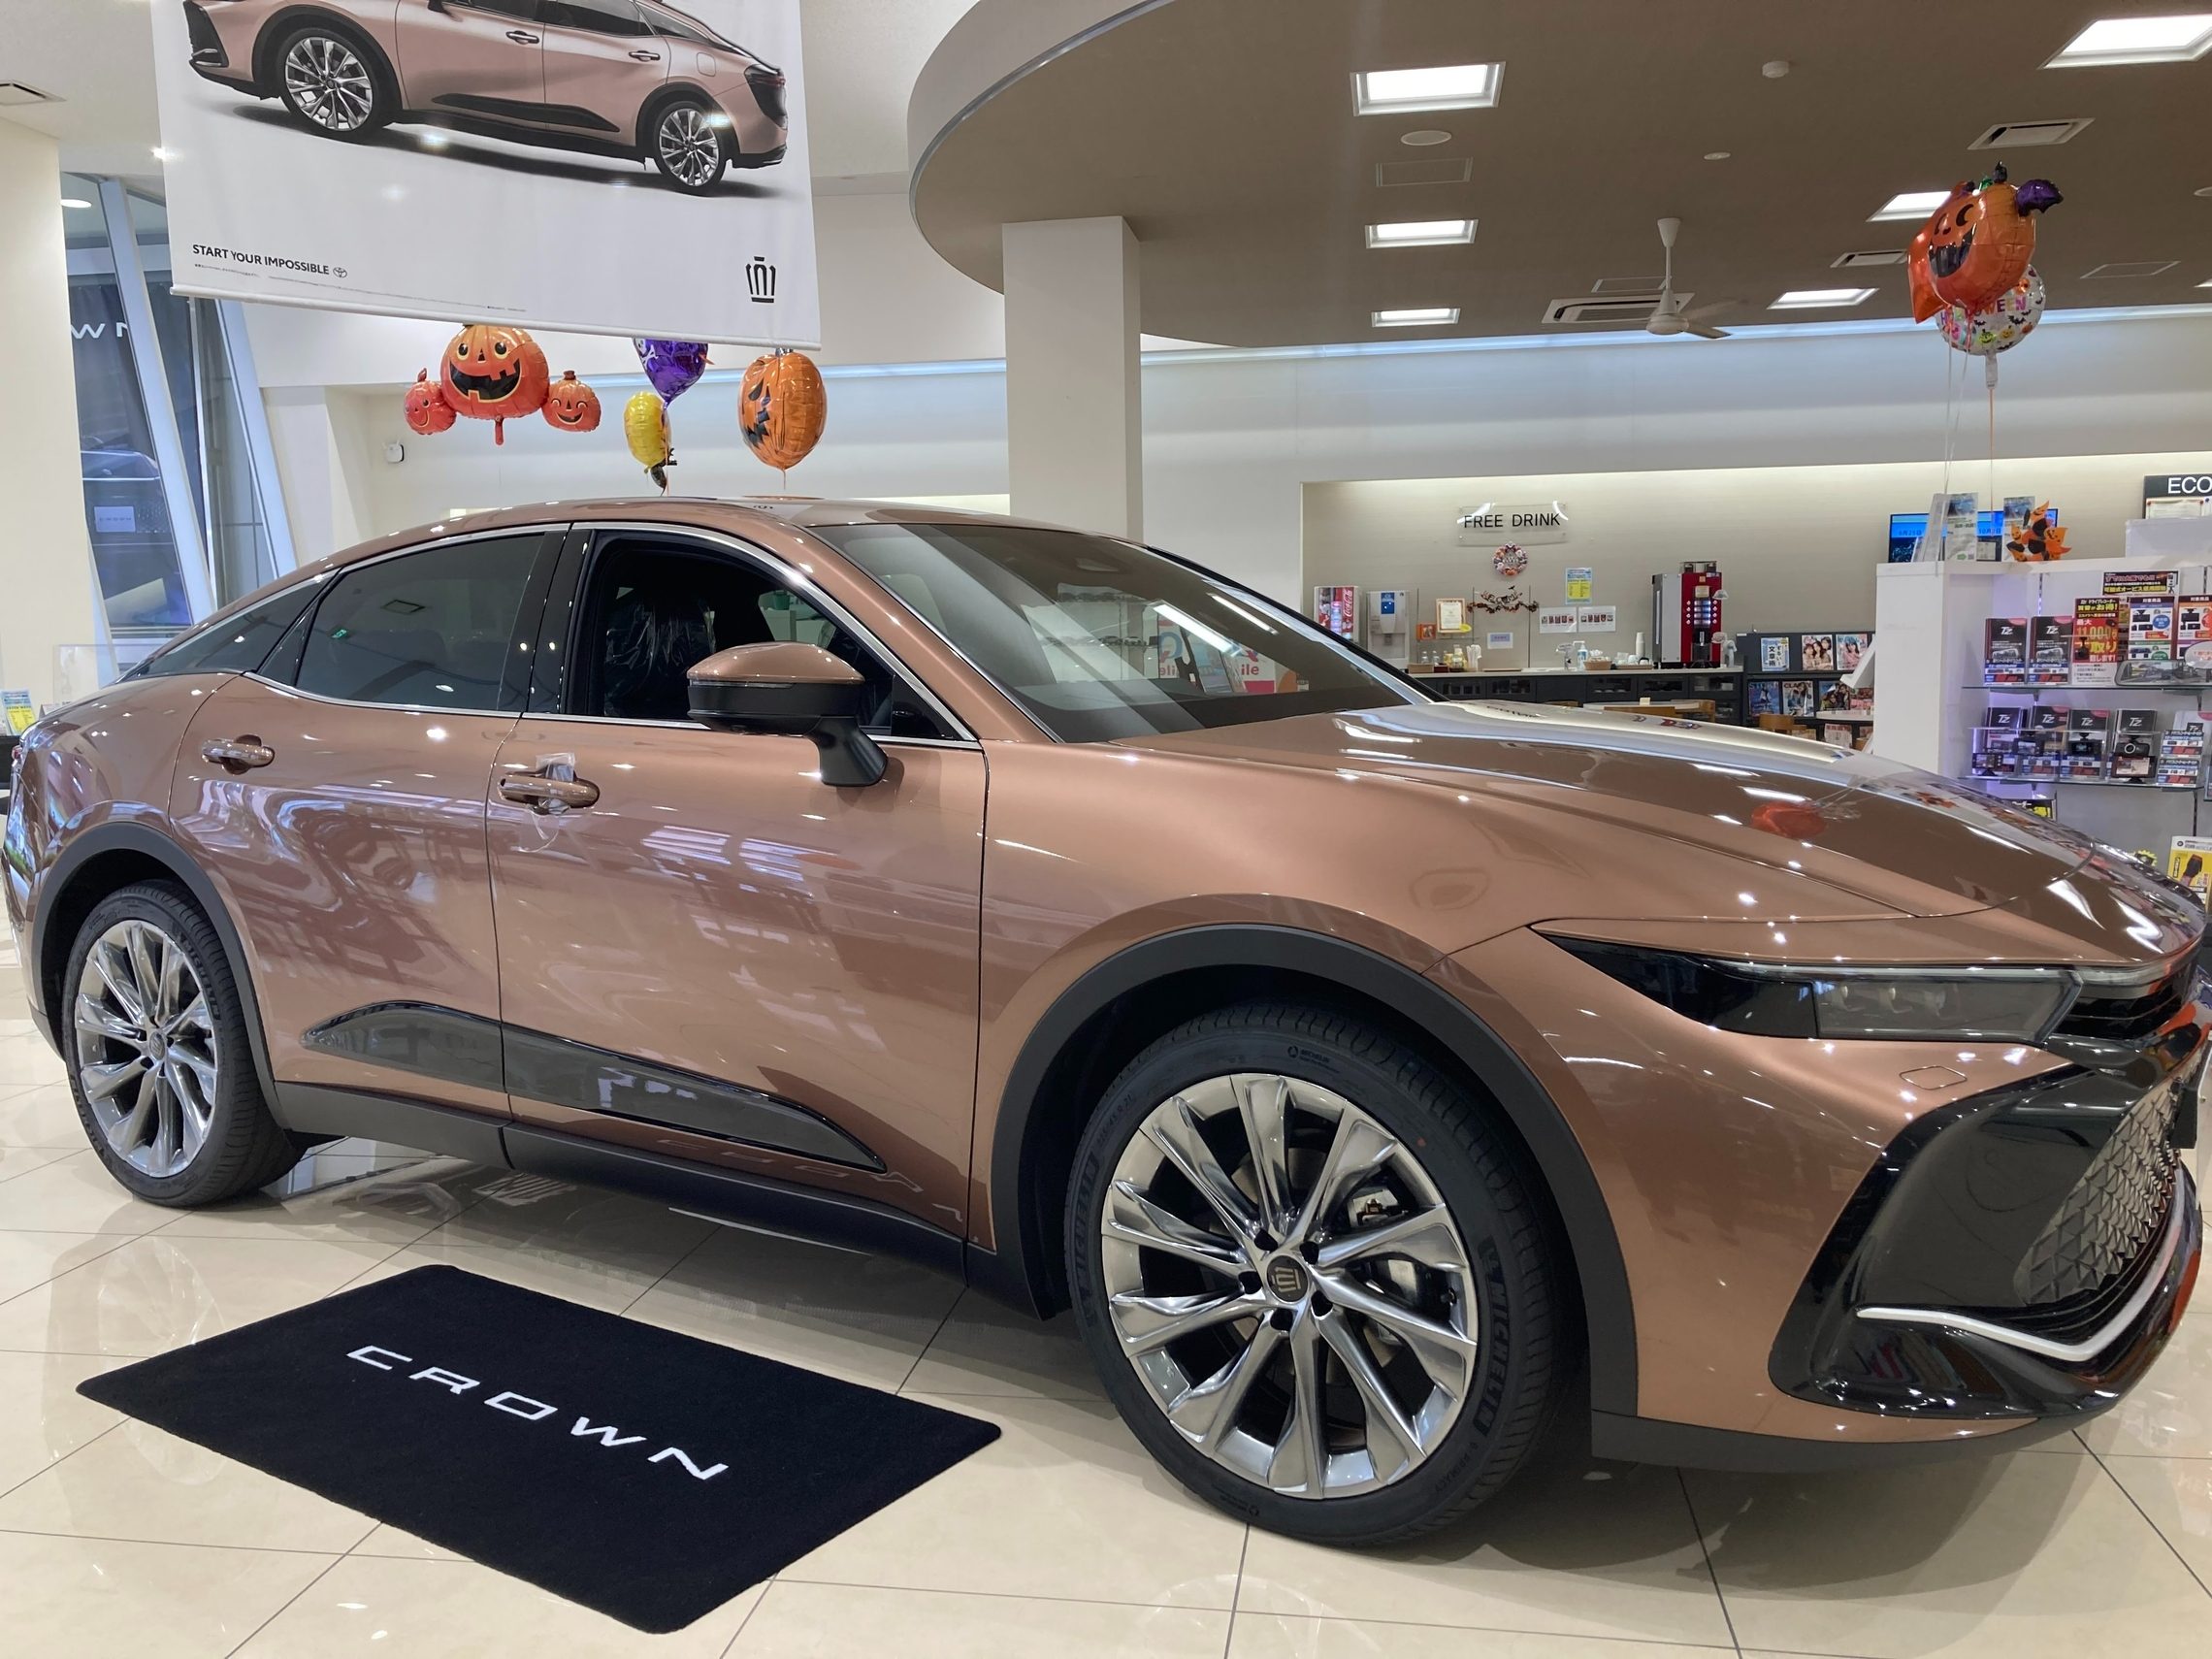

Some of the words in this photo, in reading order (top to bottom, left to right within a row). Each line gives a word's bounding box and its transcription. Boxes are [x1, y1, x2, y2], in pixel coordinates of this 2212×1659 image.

[192, 244, 229, 259] START
[231, 250, 263, 266] YOUR
[264, 256, 330, 276] IMPOSSIBLE
[2167, 476, 2212, 494] ECO
[1464, 514, 1504, 528] FREE
[1512, 513, 1560, 527] DRINK
[1476, 1283, 1510, 1429] MICHELIN
[346, 1345, 729, 1480] CROWN
